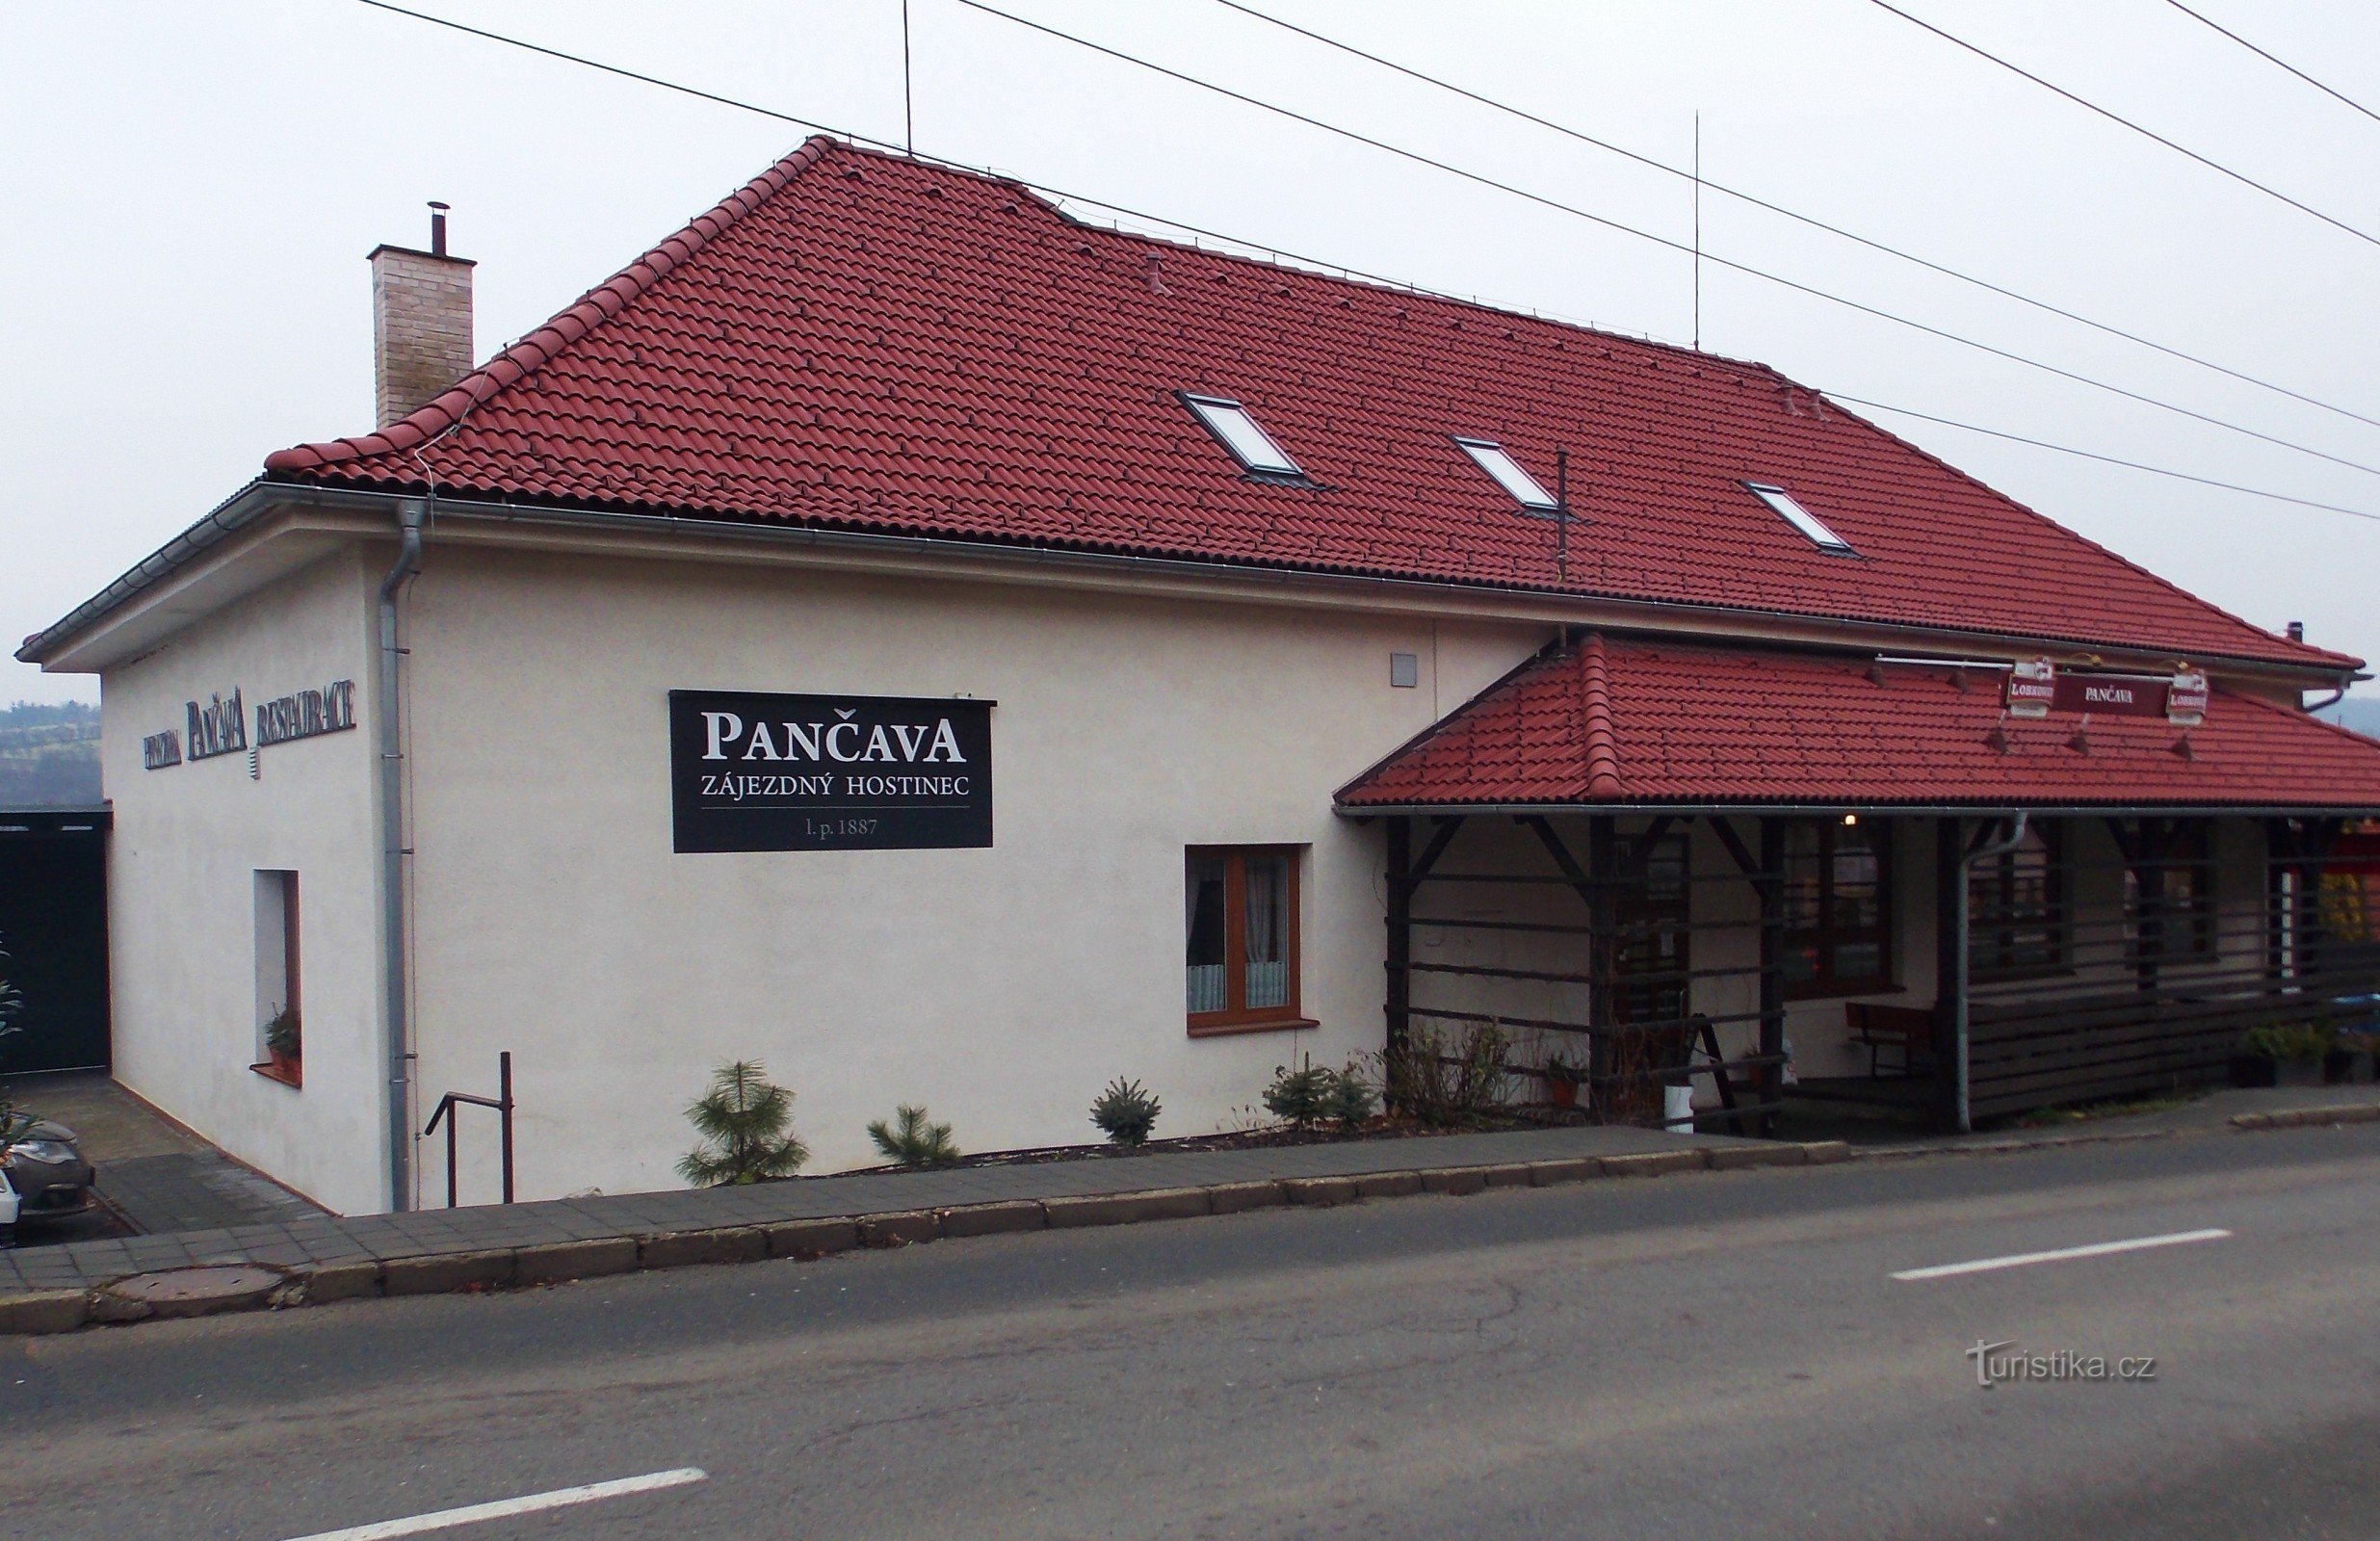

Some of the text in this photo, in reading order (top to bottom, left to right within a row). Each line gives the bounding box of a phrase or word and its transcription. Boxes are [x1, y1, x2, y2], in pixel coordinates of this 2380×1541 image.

[2085, 685, 2133, 704] PANČAVA
[700, 708, 967, 763] PANČAVA
[701, 771, 970, 801] ZÁJEZDNÝ HOSTINEC
[839, 820, 877, 835] 1887
